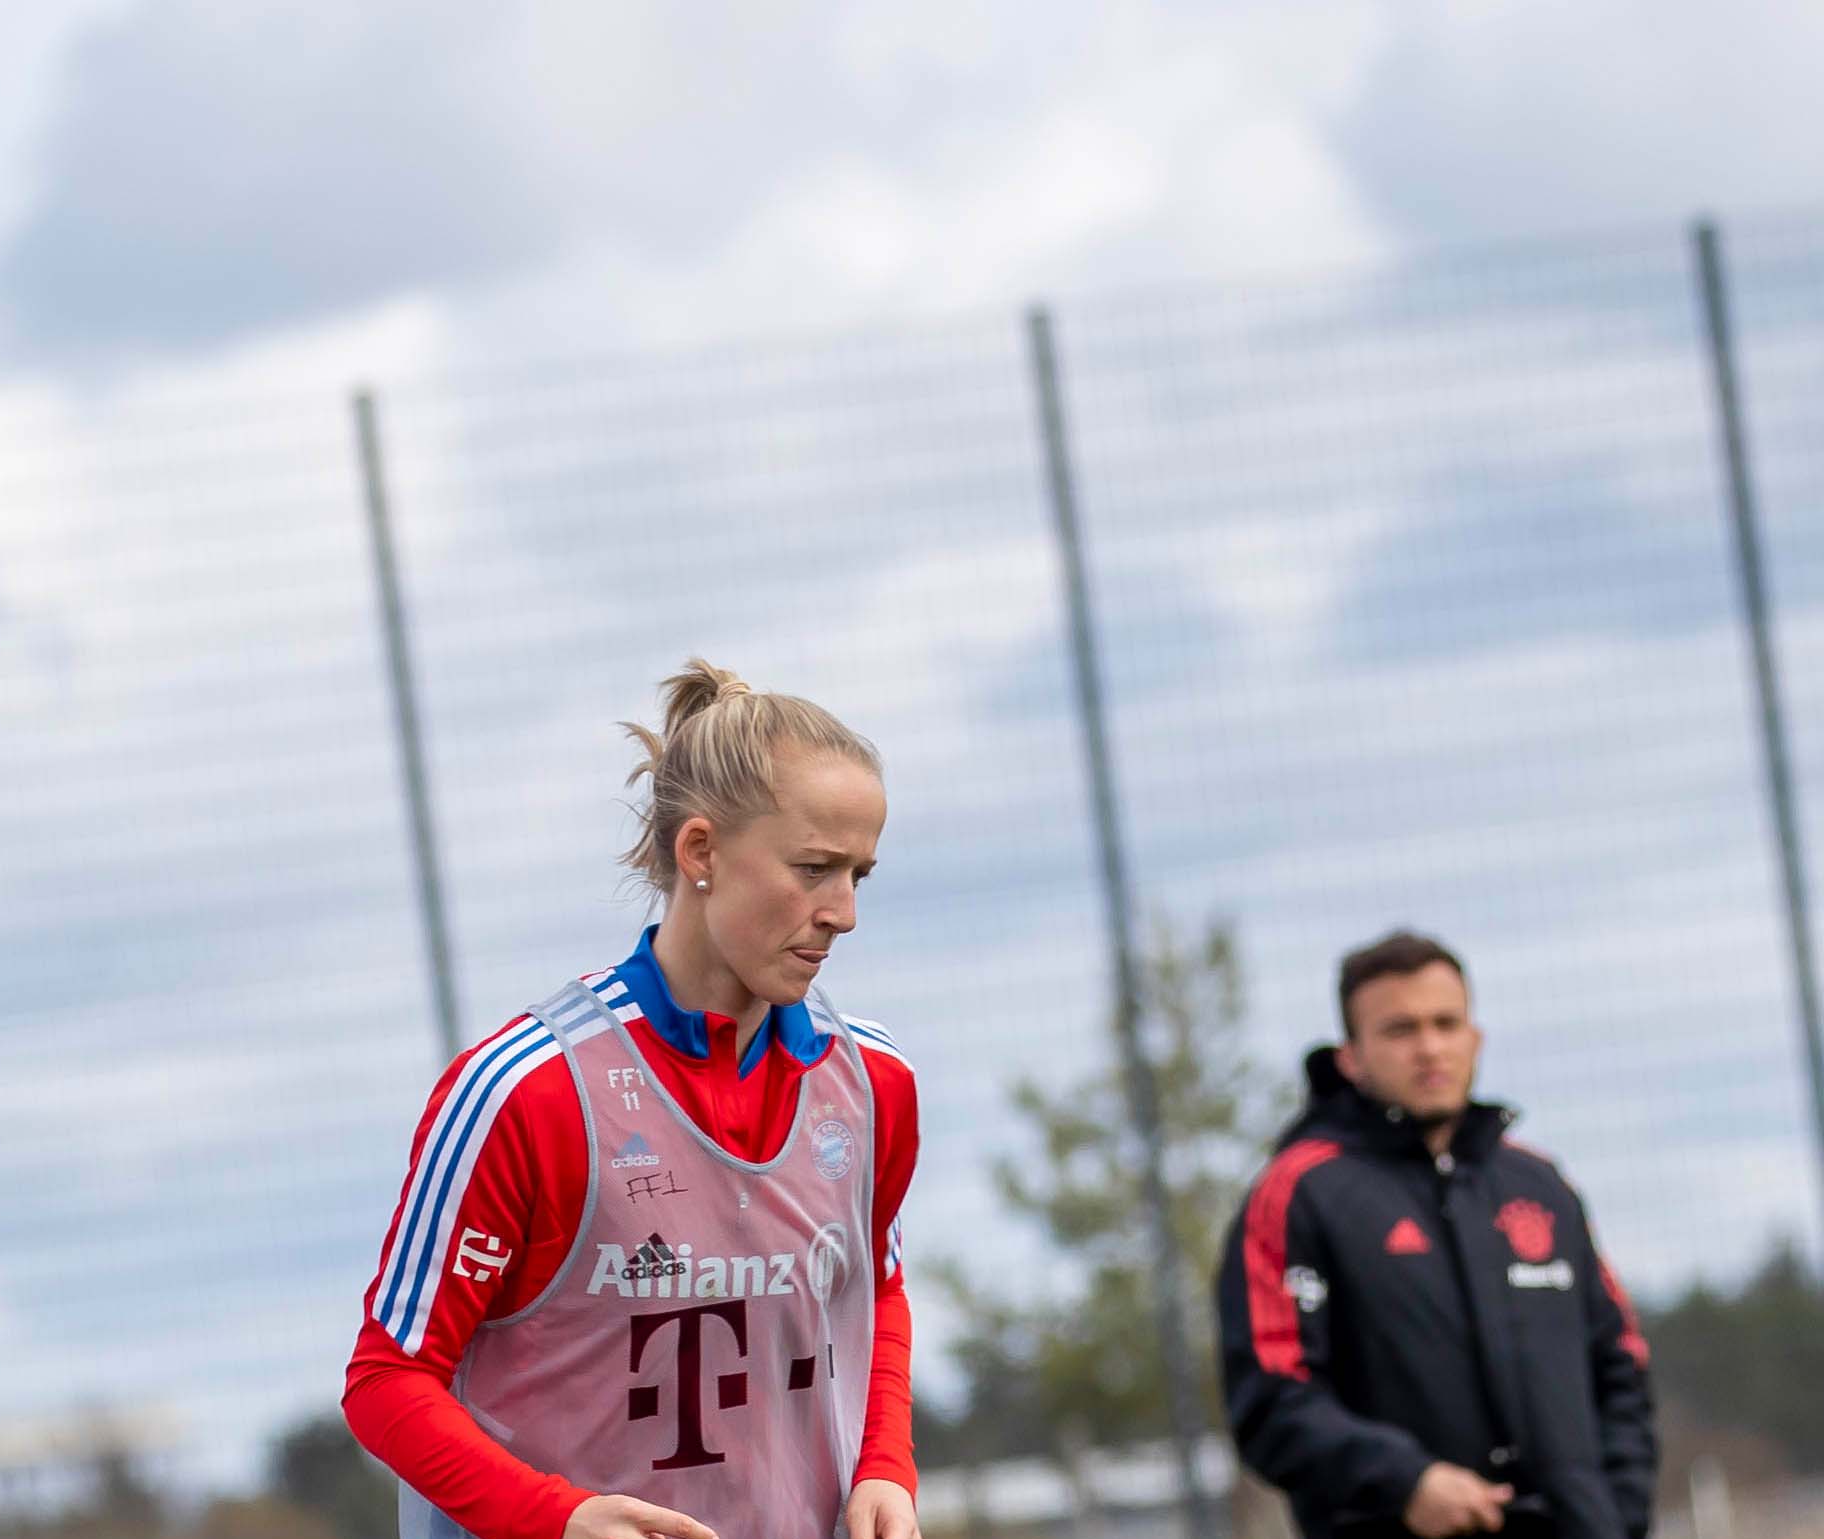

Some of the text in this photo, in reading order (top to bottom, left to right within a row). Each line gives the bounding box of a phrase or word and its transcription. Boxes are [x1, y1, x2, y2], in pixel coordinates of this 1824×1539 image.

[607, 1067, 645, 1089] FF1
[622, 1091, 640, 1111] 11
[626, 1170, 689, 1204] FF1
[587, 1243, 795, 1298] Allianz
[621, 1261, 687, 1280] adidas
